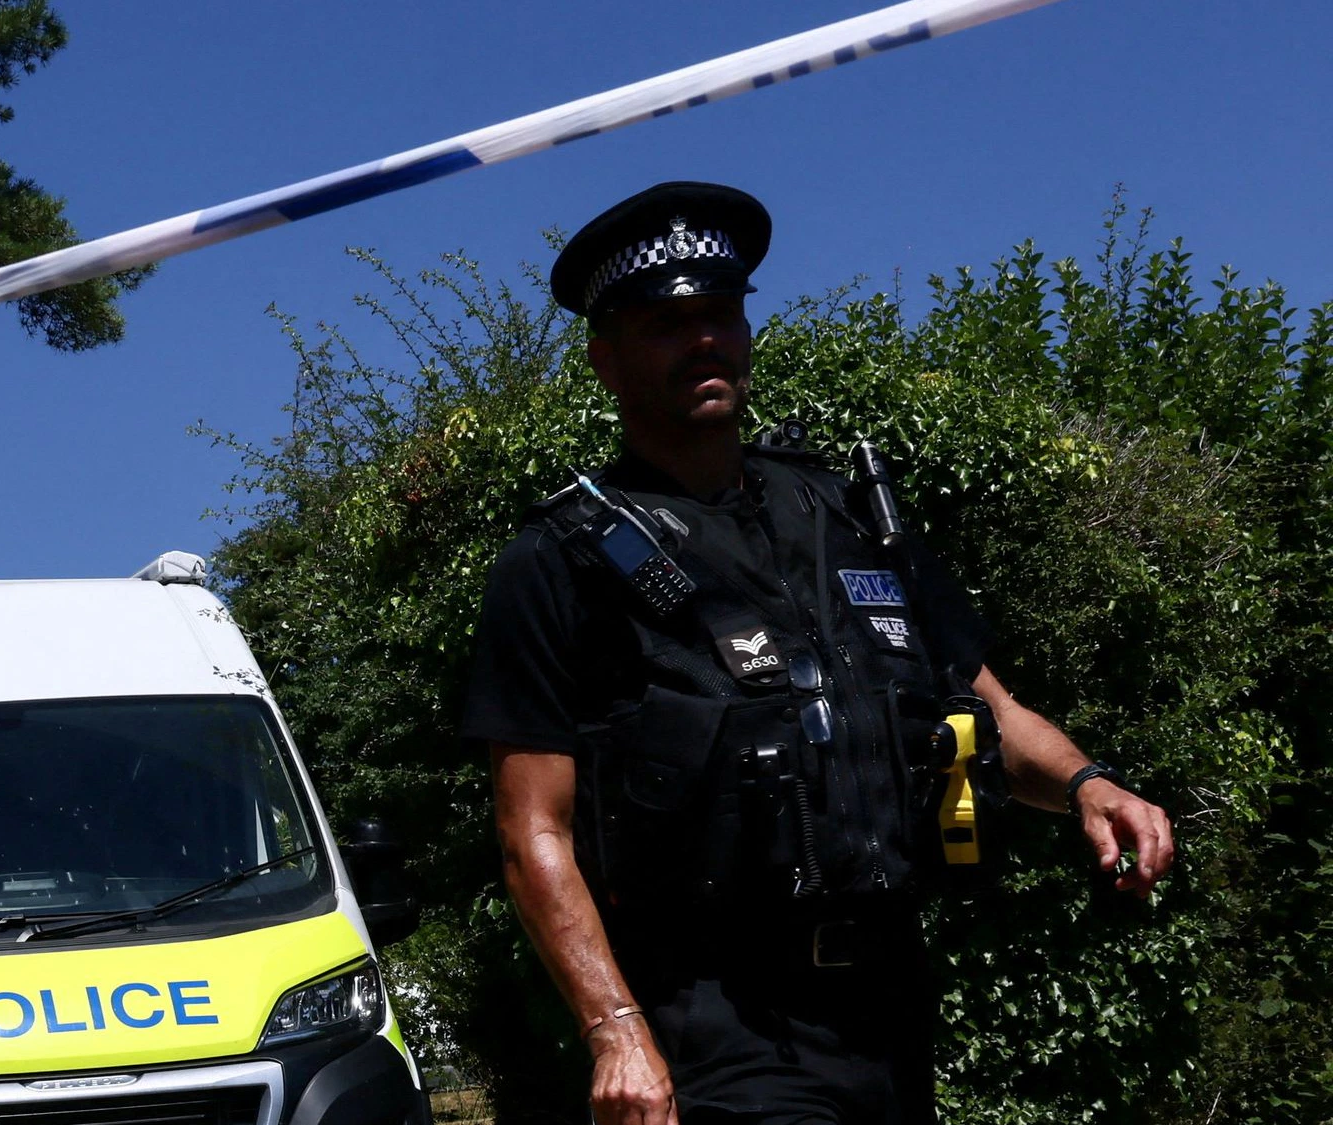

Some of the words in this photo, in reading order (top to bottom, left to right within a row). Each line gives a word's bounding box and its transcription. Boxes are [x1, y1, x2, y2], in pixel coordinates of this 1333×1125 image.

[845, 574, 902, 601] POLICE
[871, 621, 909, 636] POLICE
[741, 655, 778, 671] 5630
